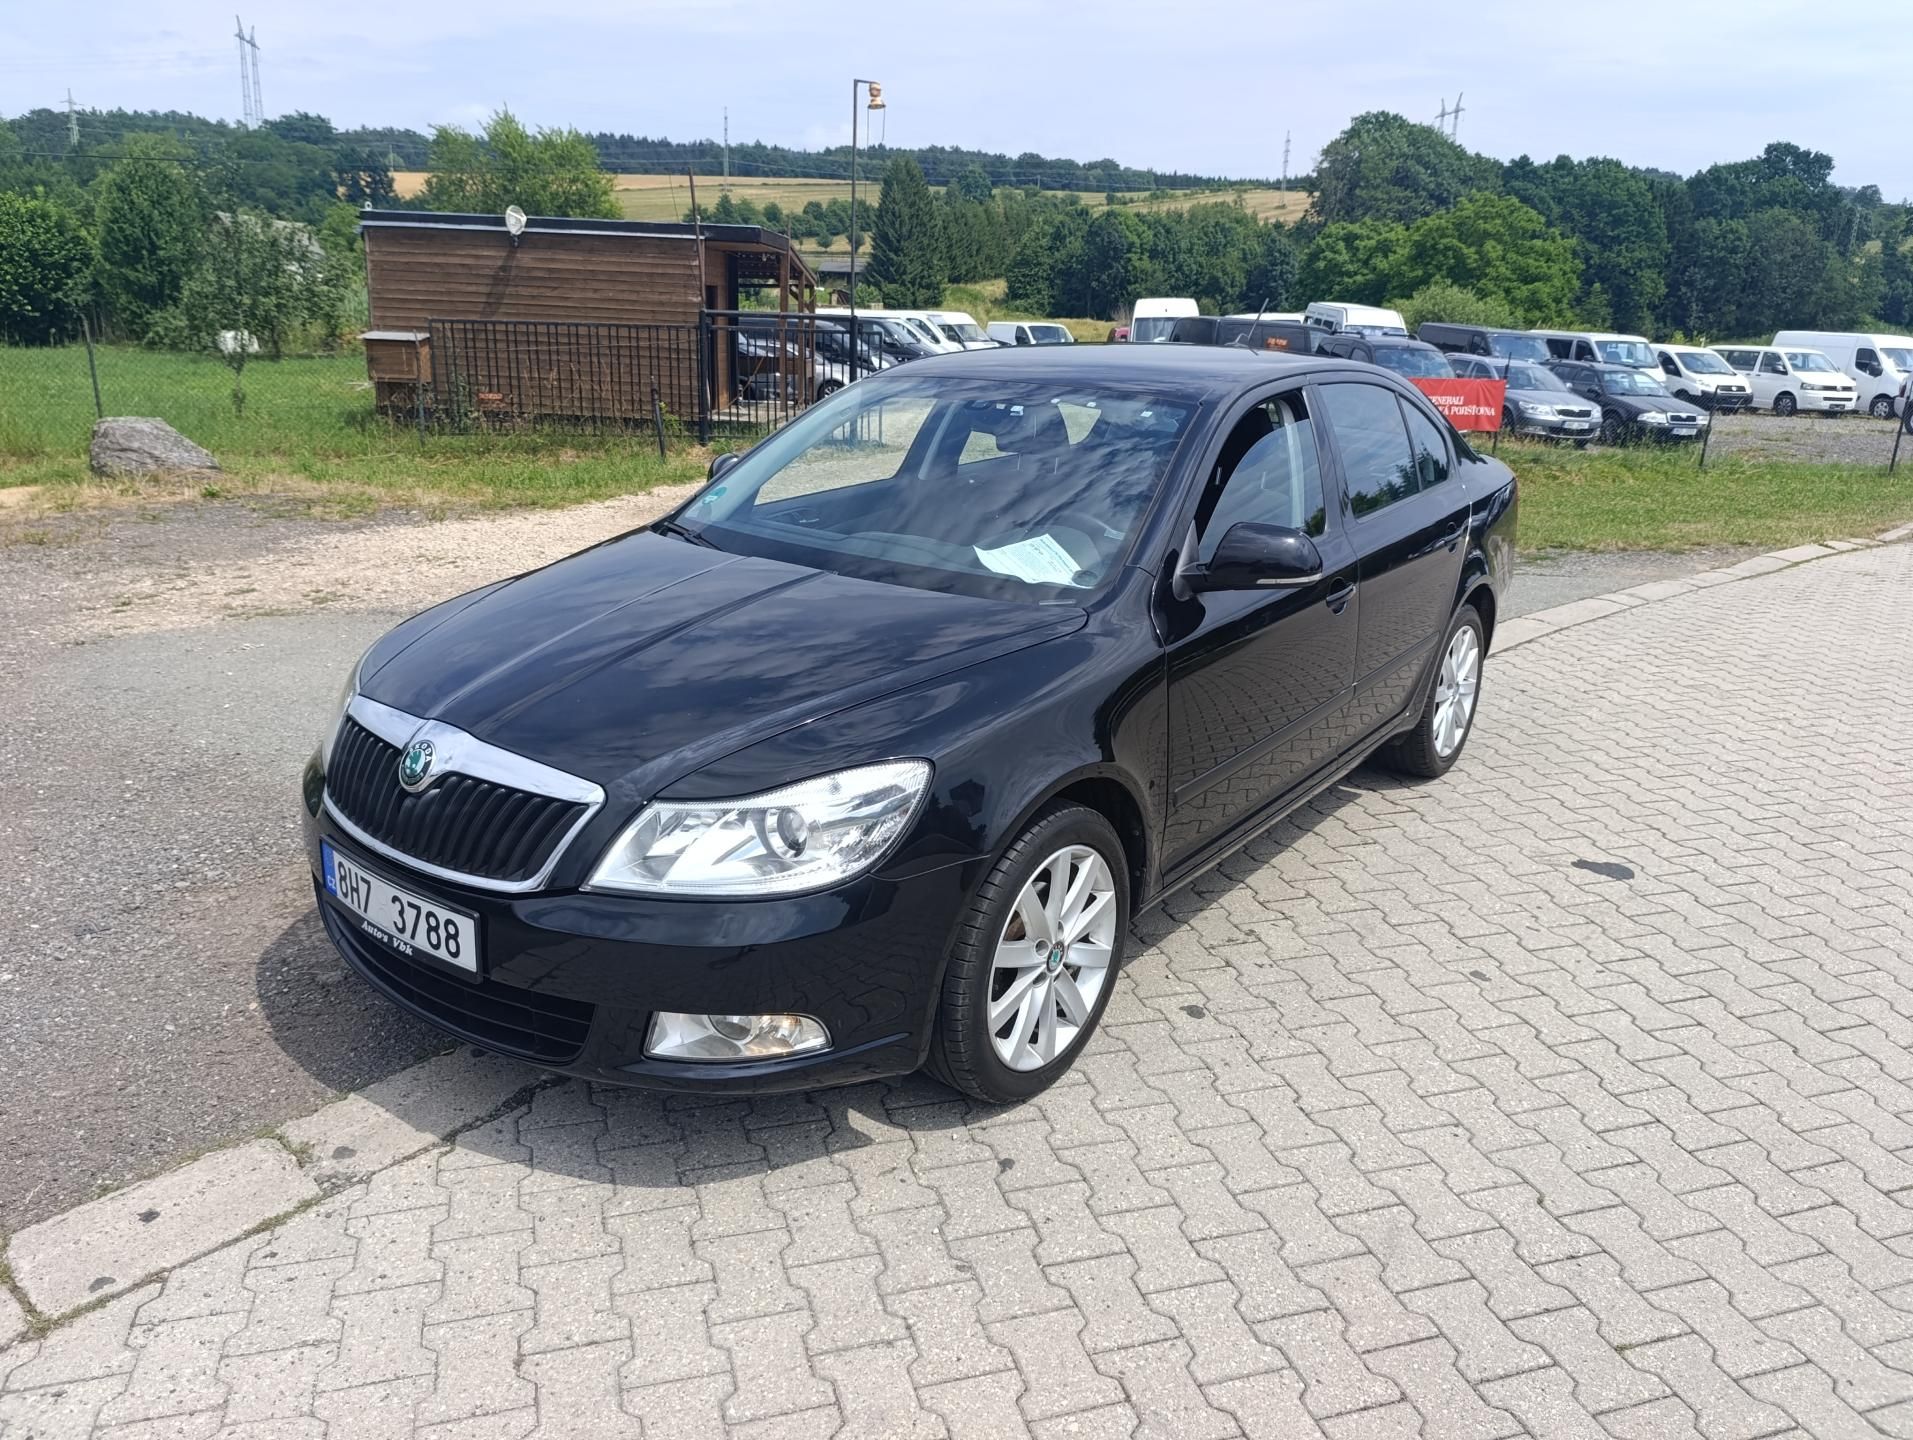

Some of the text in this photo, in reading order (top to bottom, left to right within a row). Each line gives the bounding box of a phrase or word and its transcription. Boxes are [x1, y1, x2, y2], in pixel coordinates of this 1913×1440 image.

[327, 875, 336, 889] CZ
[338, 861, 461, 959] 8H7 3788
